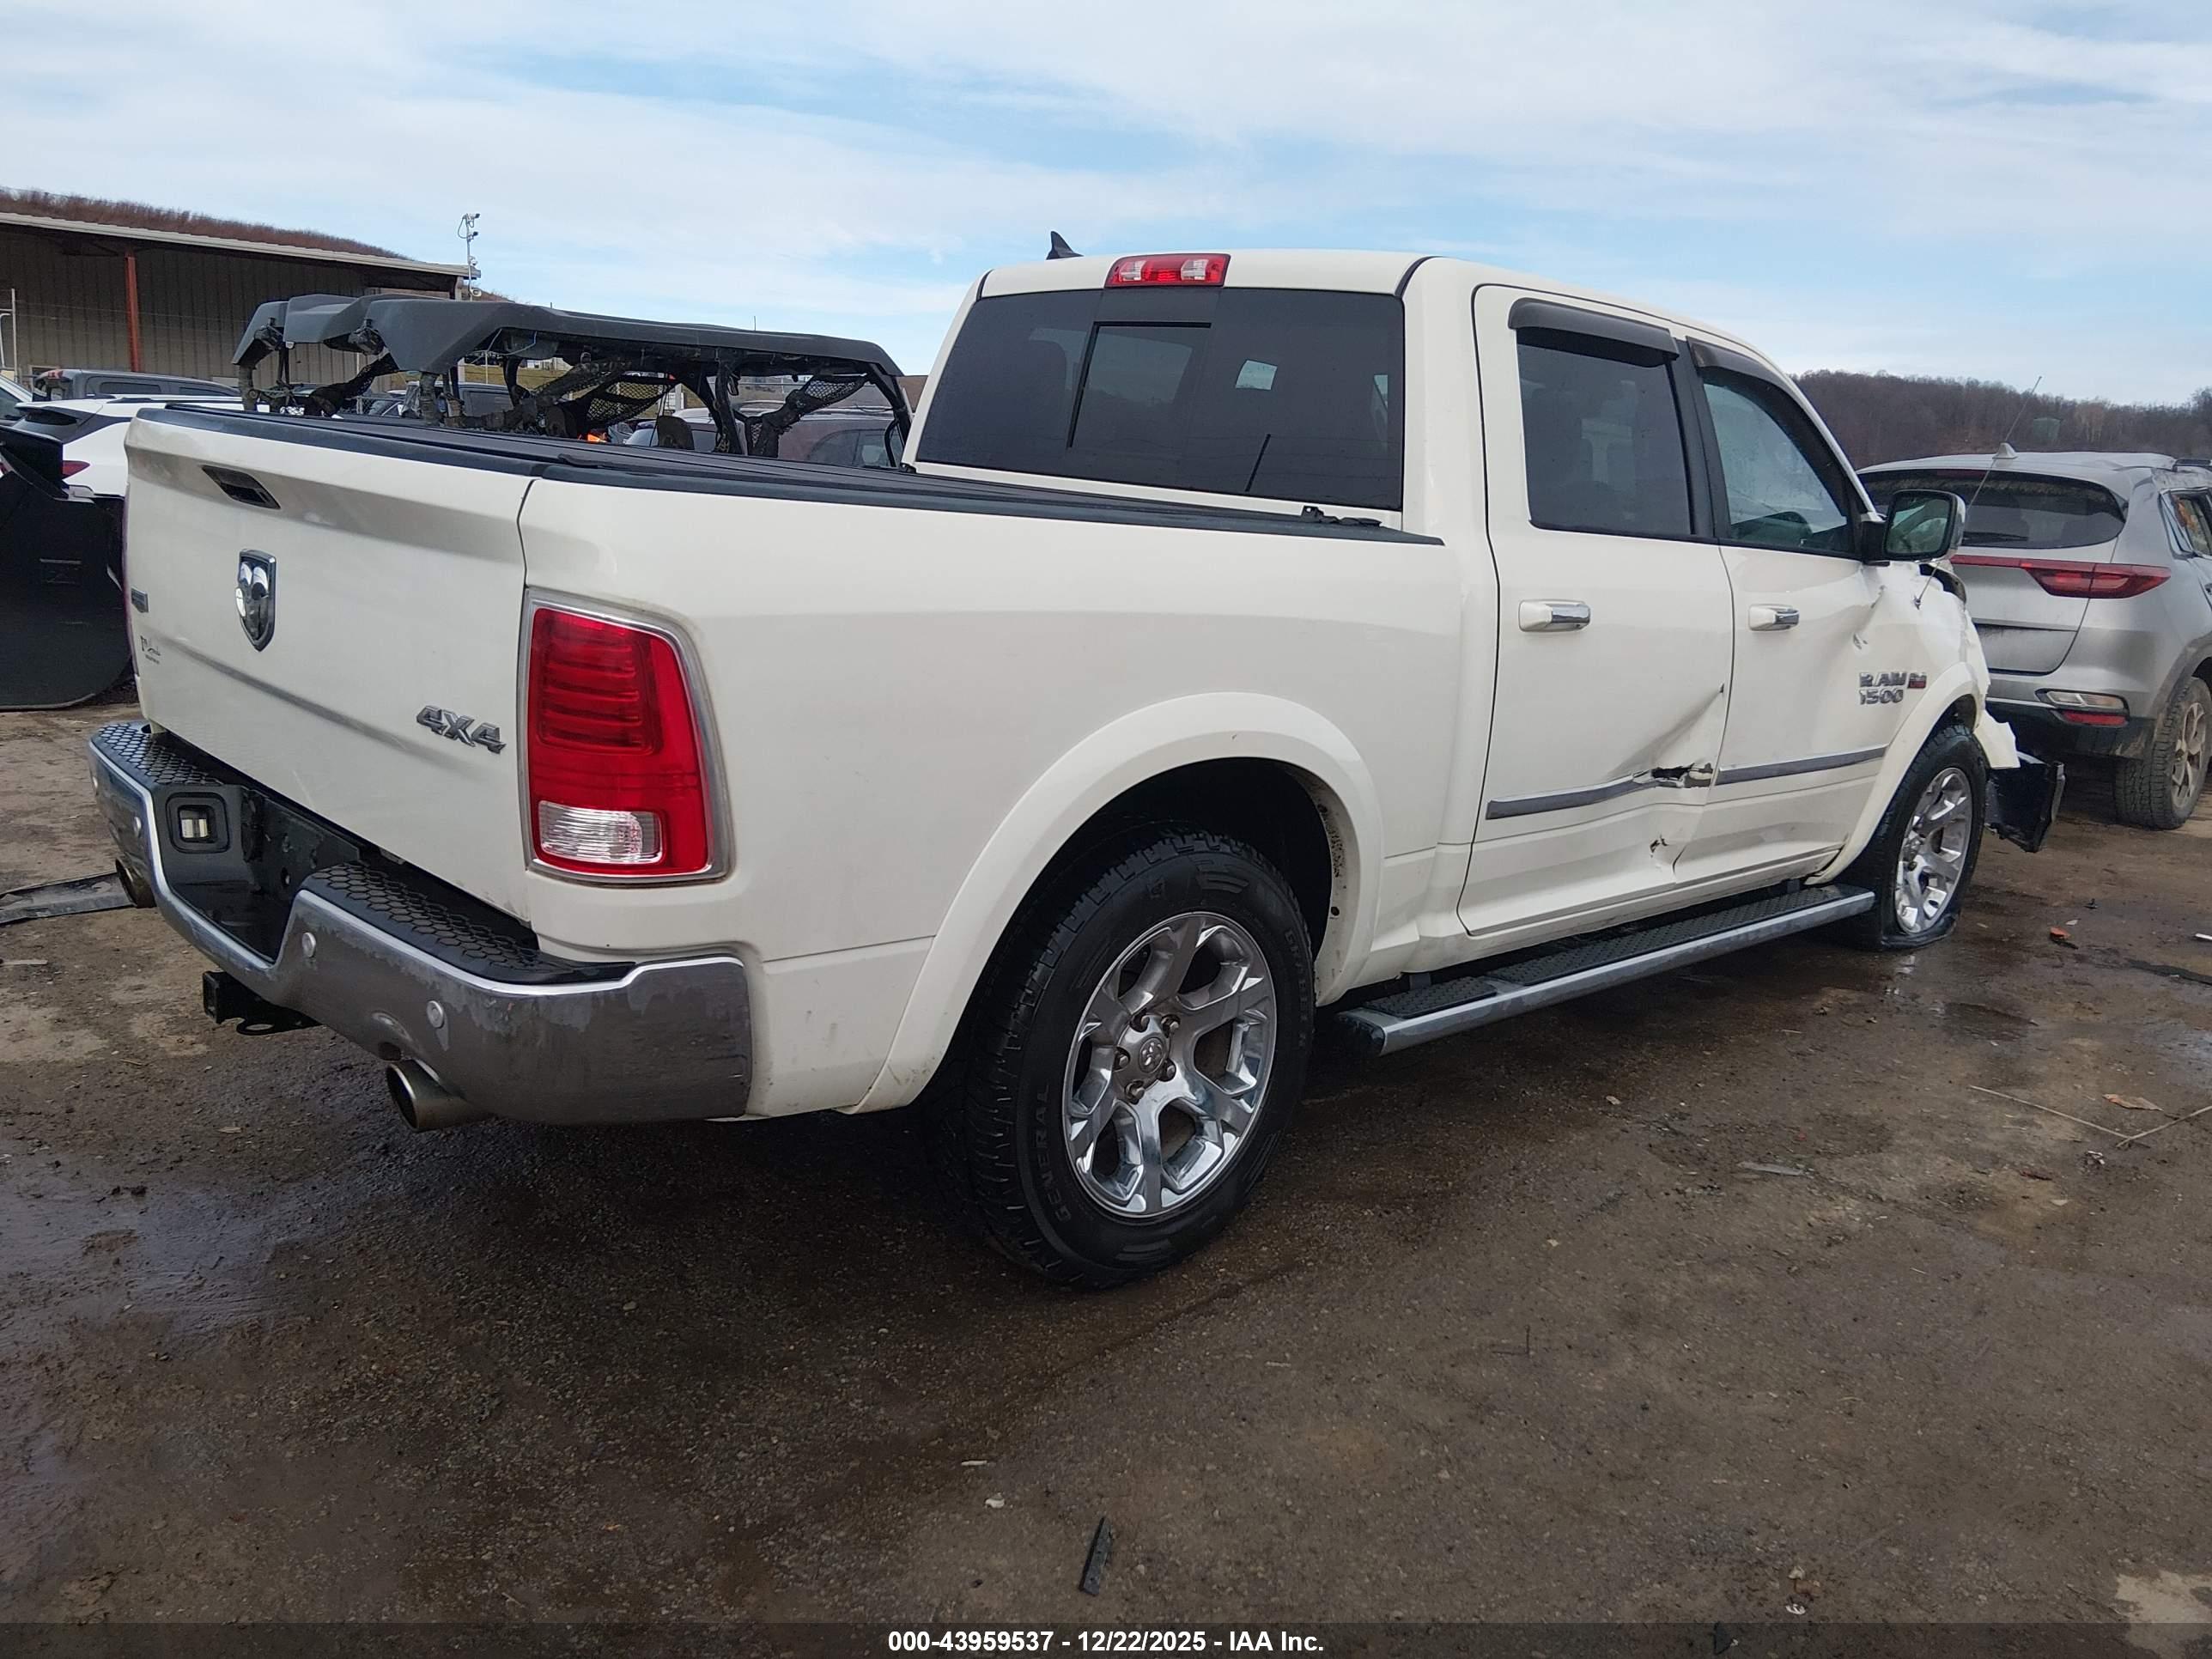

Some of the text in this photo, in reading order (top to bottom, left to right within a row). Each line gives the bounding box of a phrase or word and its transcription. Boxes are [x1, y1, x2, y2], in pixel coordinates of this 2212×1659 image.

[1859, 672, 1907, 687] RAM
[1859, 689, 1904, 705] 1500
[1036, 1080, 1072, 1223] GENERAL
